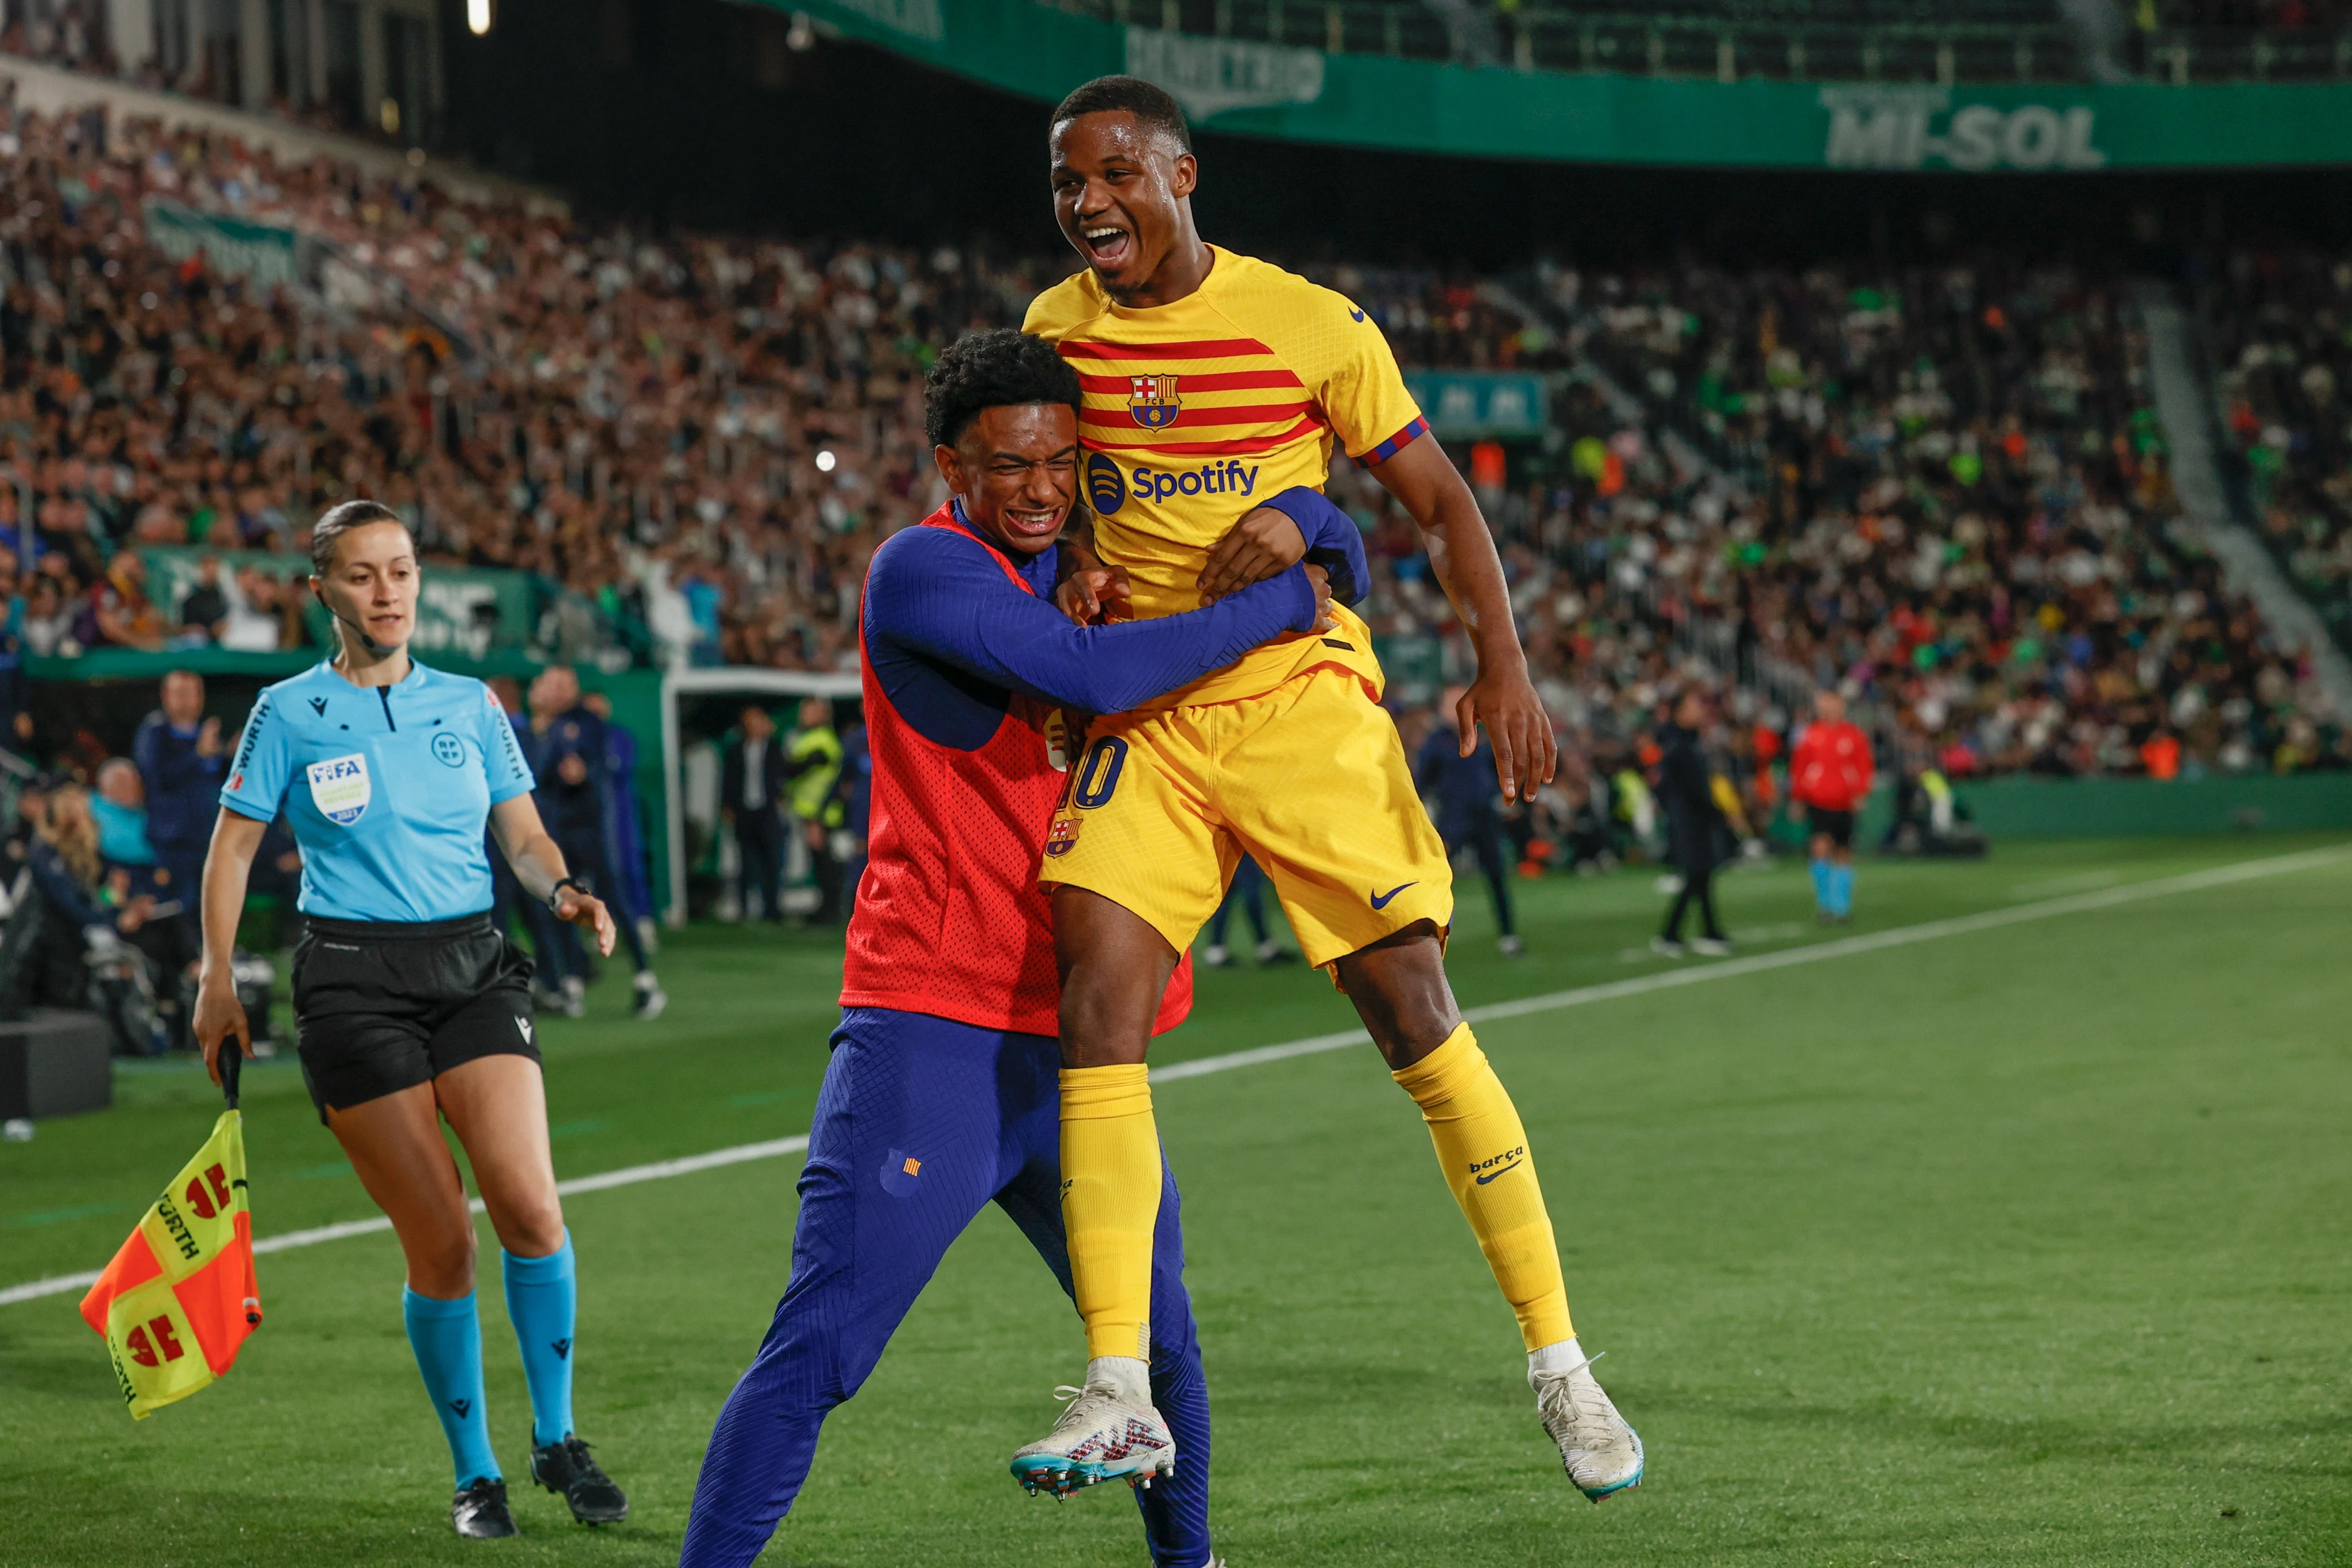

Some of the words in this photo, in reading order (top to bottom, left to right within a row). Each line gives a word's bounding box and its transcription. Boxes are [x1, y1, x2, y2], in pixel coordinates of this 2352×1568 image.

[1132, 460, 1259, 504] Spotify
[313, 760, 360, 783] FIFA
[1469, 1146, 1523, 1174] barça
[157, 1193, 200, 1260] ÜRTH
